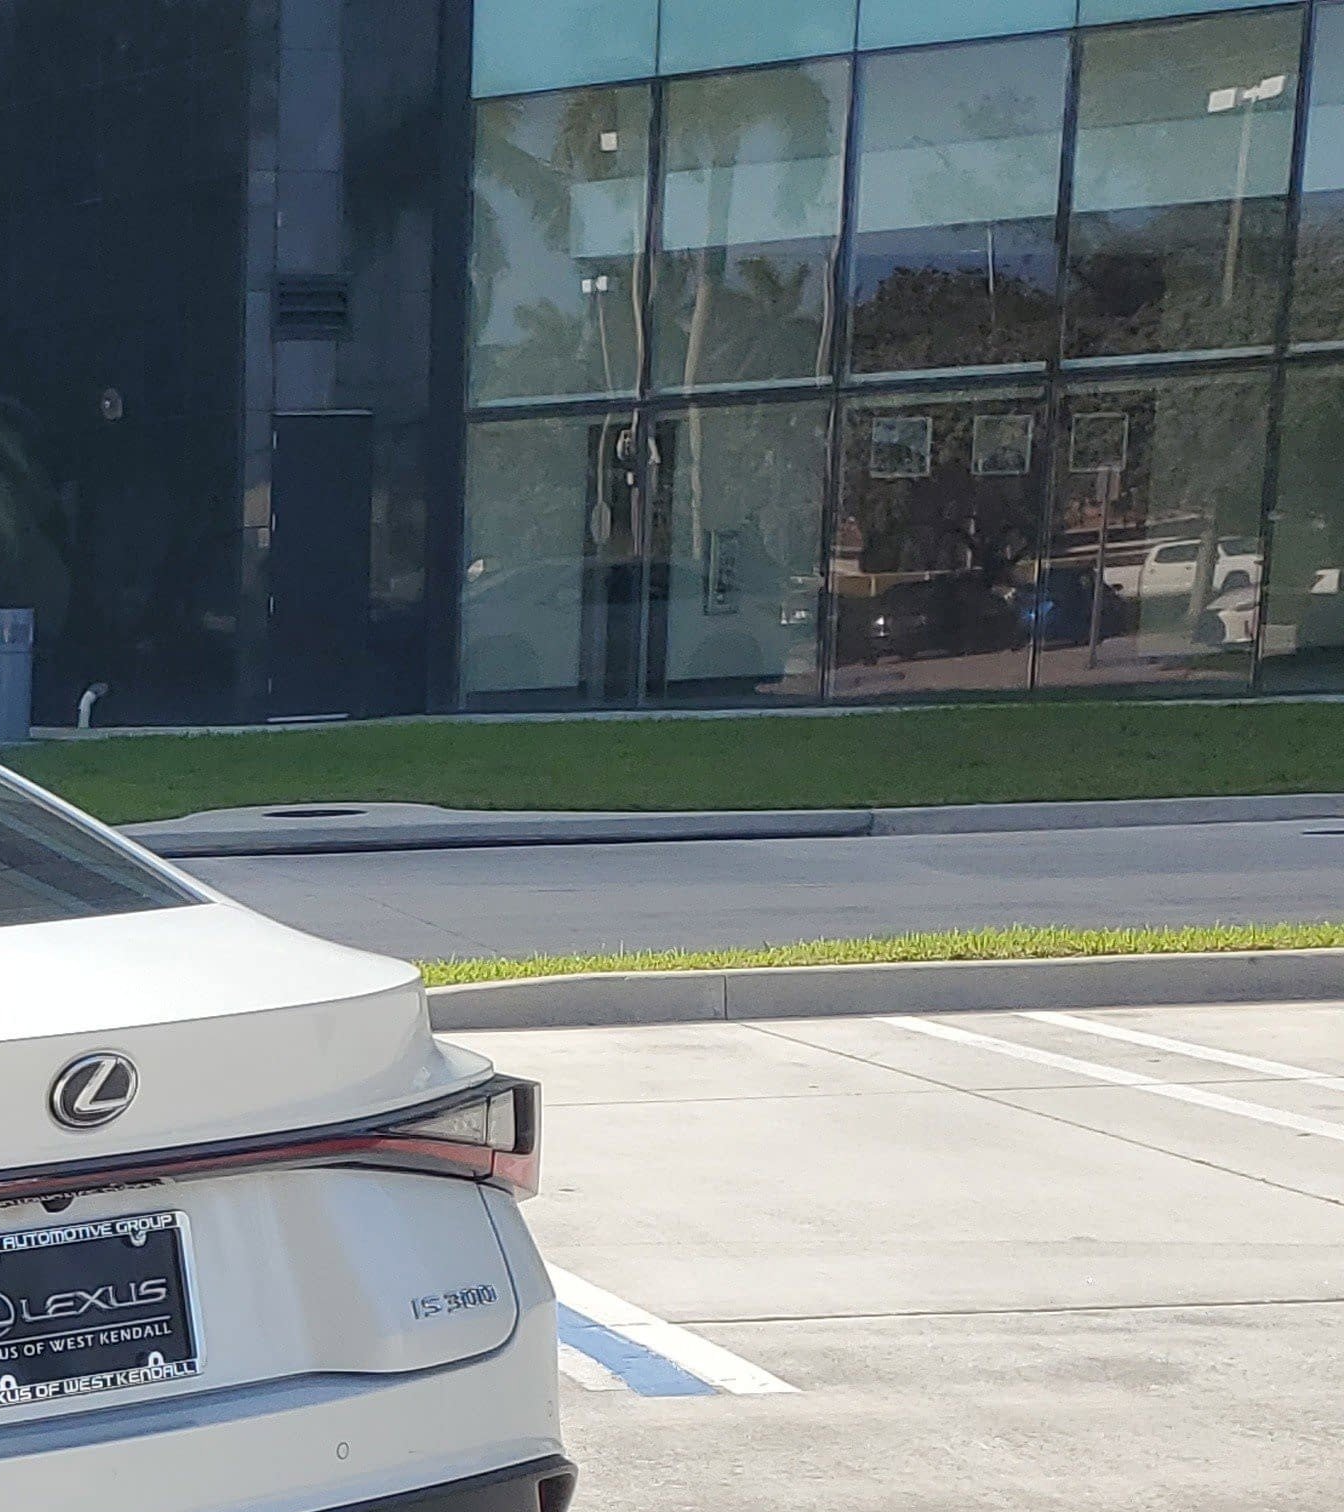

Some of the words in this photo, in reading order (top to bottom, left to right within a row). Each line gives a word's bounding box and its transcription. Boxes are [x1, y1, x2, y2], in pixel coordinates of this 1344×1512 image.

[2, 1220, 113, 1250] AUTOMOTIVE
[115, 1214, 172, 1234] GROUP
[20, 1279, 167, 1322] LEXUS
[411, 1297, 442, 1320] IS
[443, 1284, 498, 1314] 300
[23, 1342, 45, 1357] OF
[49, 1334, 94, 1353] WEST
[99, 1321, 172, 1346] KENDALL
[36, 1383, 60, 1398] OF
[63, 1374, 114, 1394] WEST
[116, 1362, 195, 1386] KENDALL
